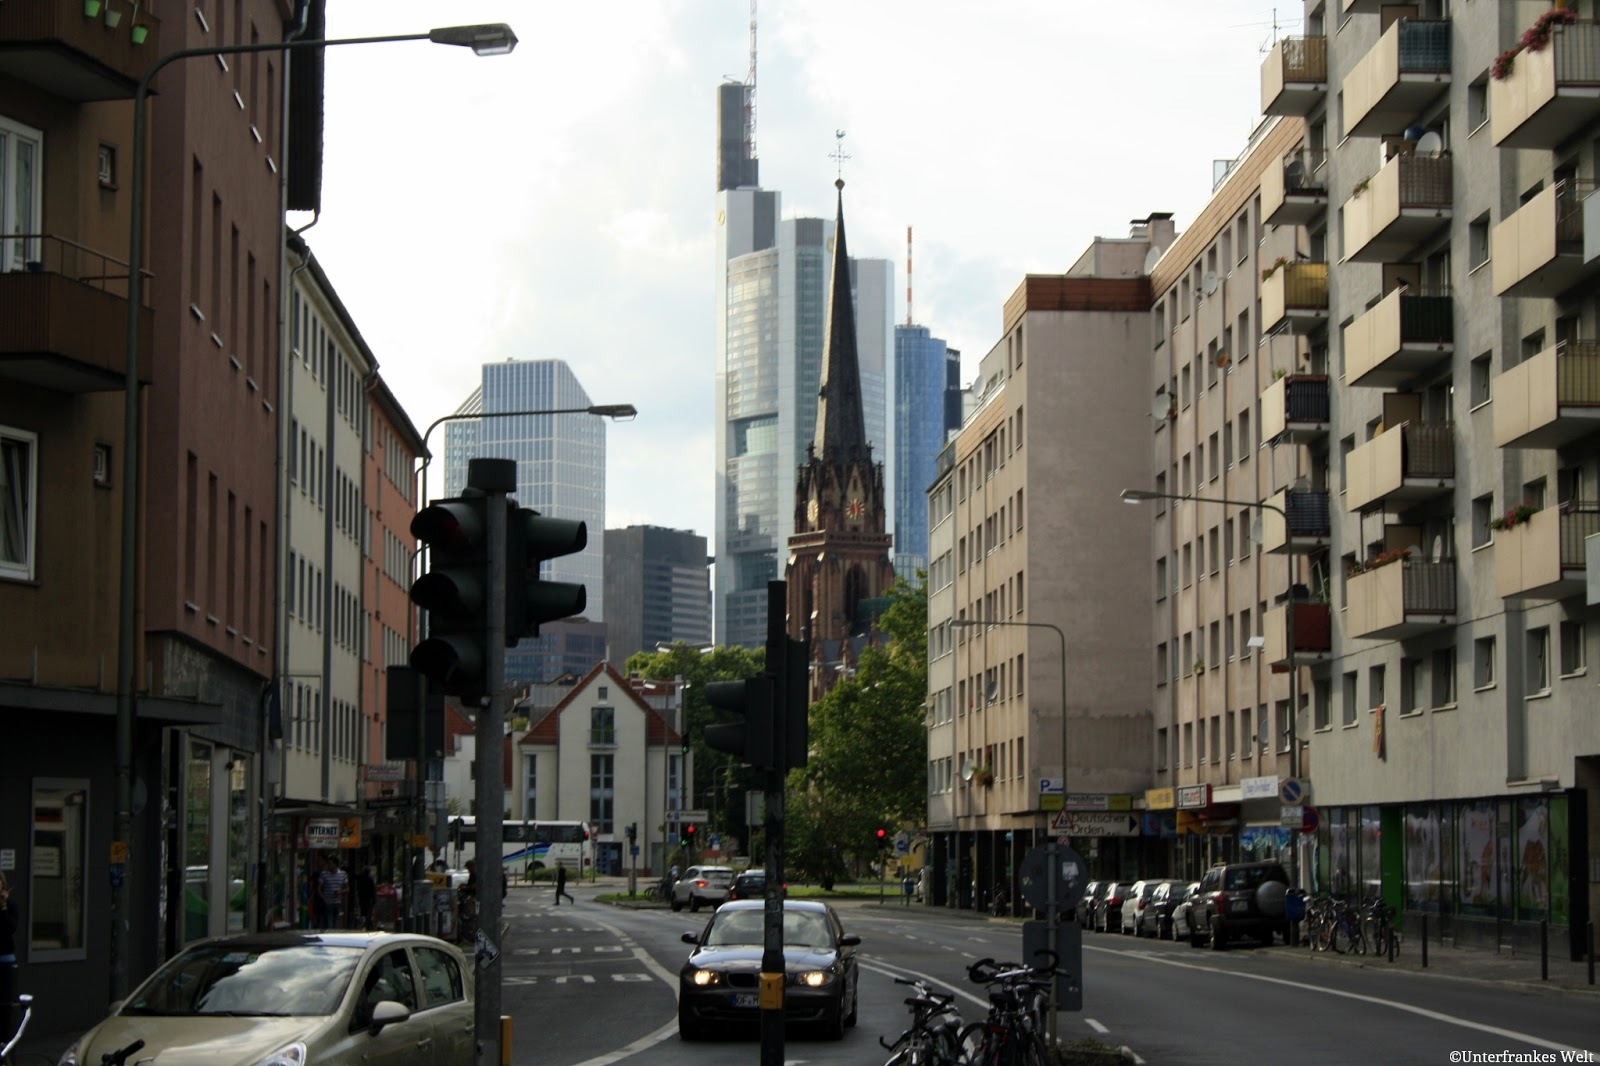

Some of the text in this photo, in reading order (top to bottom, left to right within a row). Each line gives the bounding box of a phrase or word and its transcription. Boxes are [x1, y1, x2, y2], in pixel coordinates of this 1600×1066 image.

[1071, 812, 1126, 823] Deutscher
[308, 826, 337, 835] INTERNET
[1071, 824, 1105, 835] Orden
